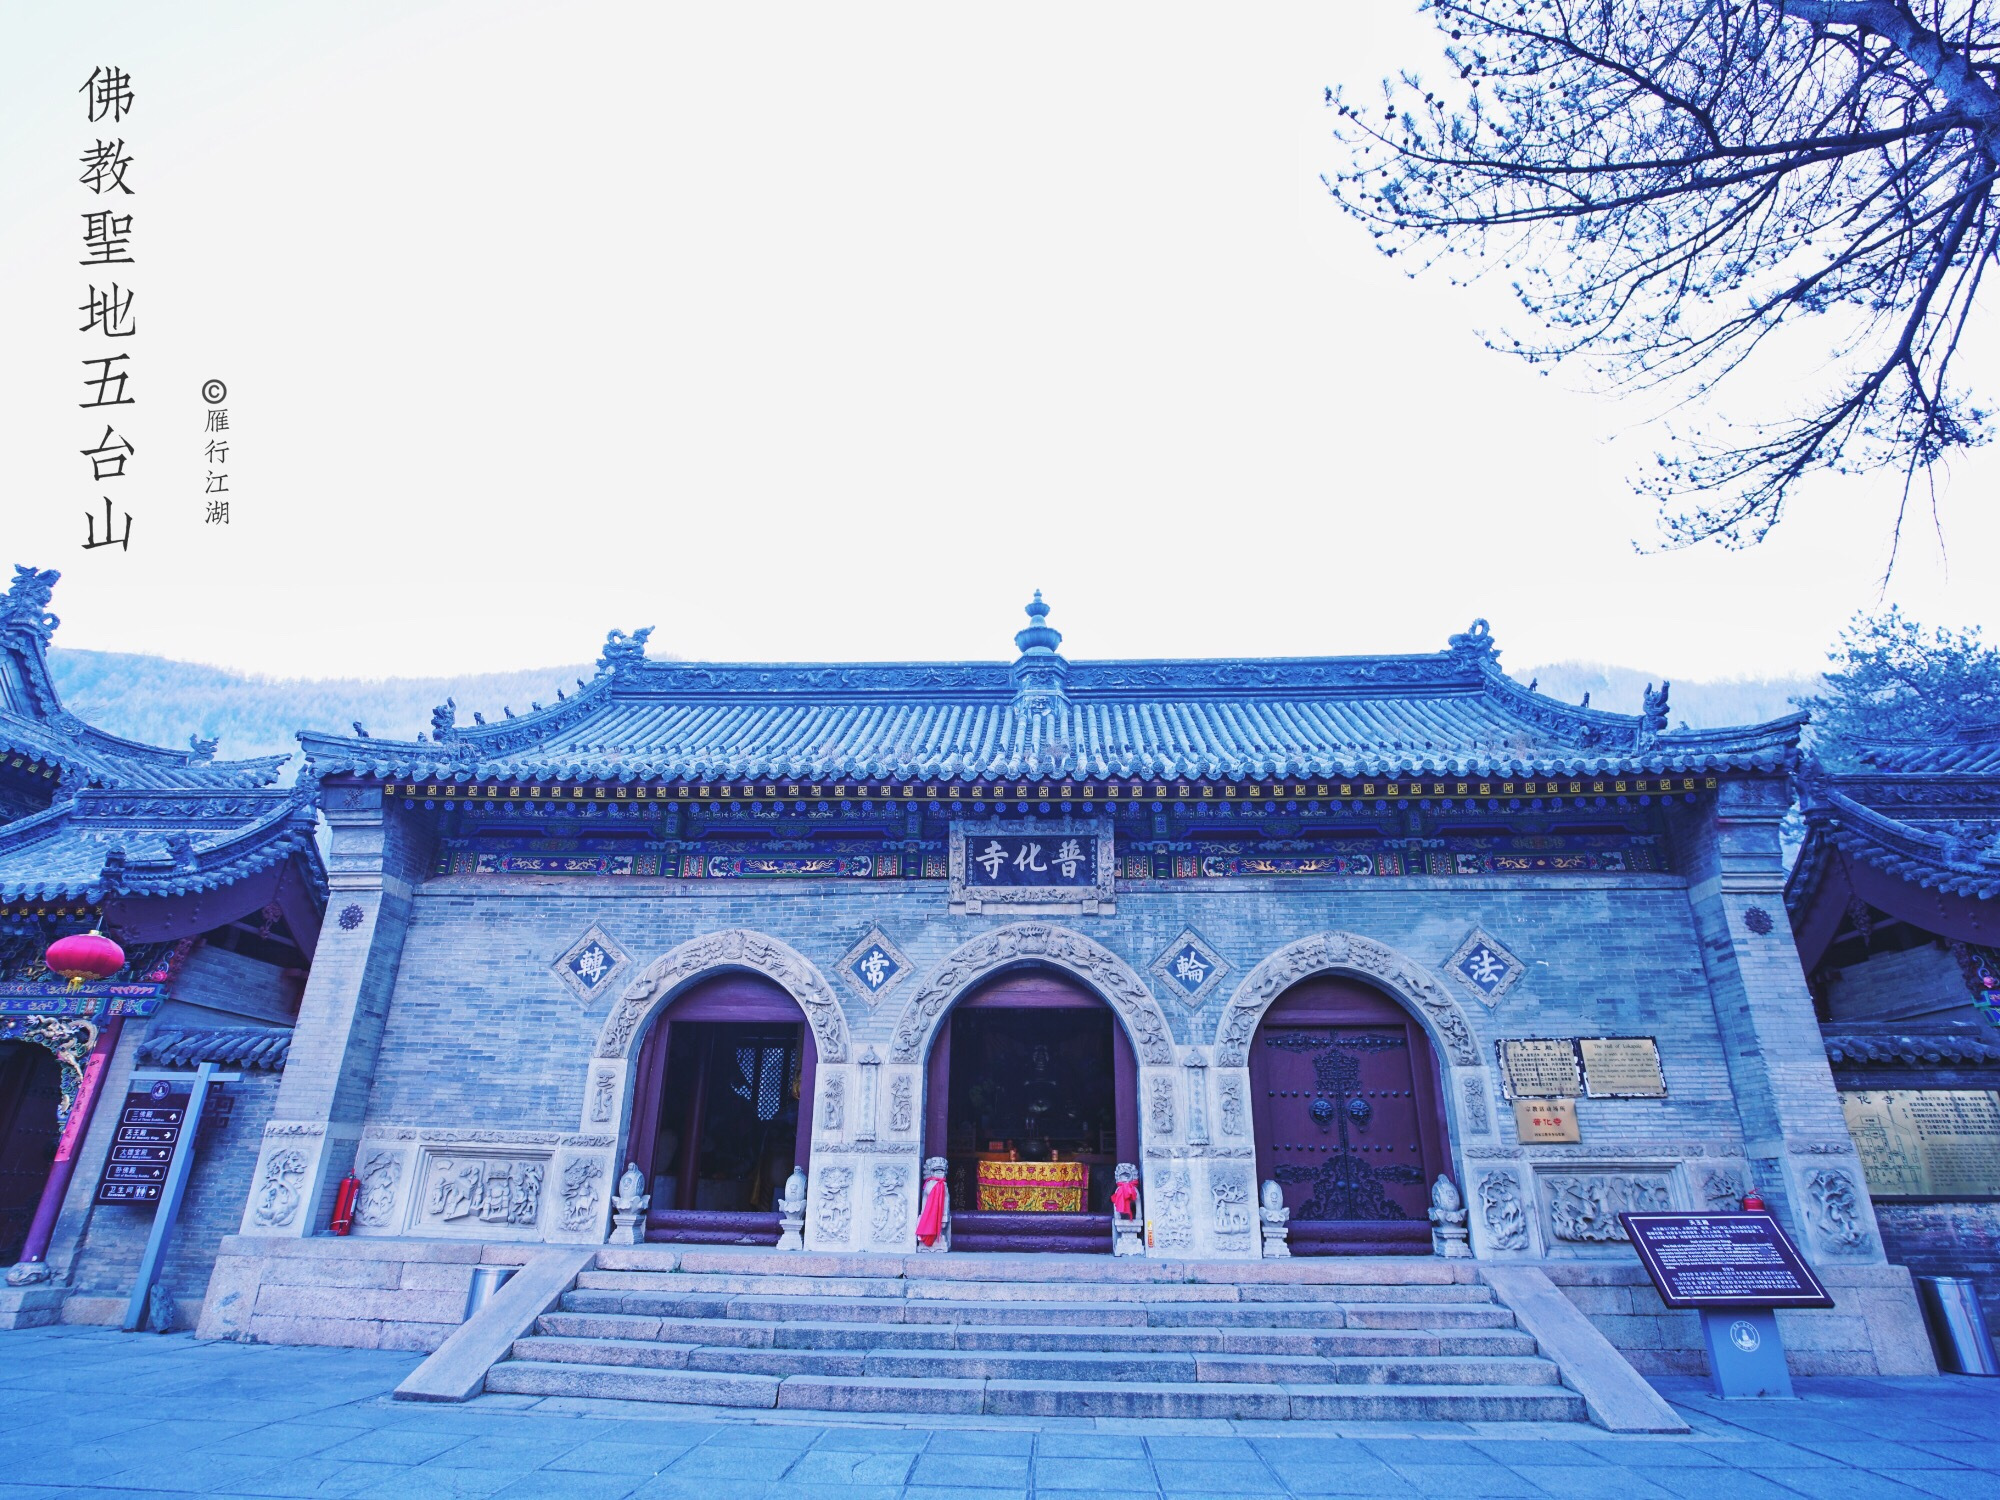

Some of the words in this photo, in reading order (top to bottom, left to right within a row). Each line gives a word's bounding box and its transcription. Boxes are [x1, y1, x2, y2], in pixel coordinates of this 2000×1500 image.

[975, 838, 1087, 880] 普化寺
[576, 945, 608, 983] 轉
[861, 950, 890, 987] 常
[1175, 951, 1209, 984] 輪
[1469, 948, 1504, 983] 法
[1532, 1117, 1562, 1127] 普化寺
[953, 1165, 967, 1211] 廣種福
